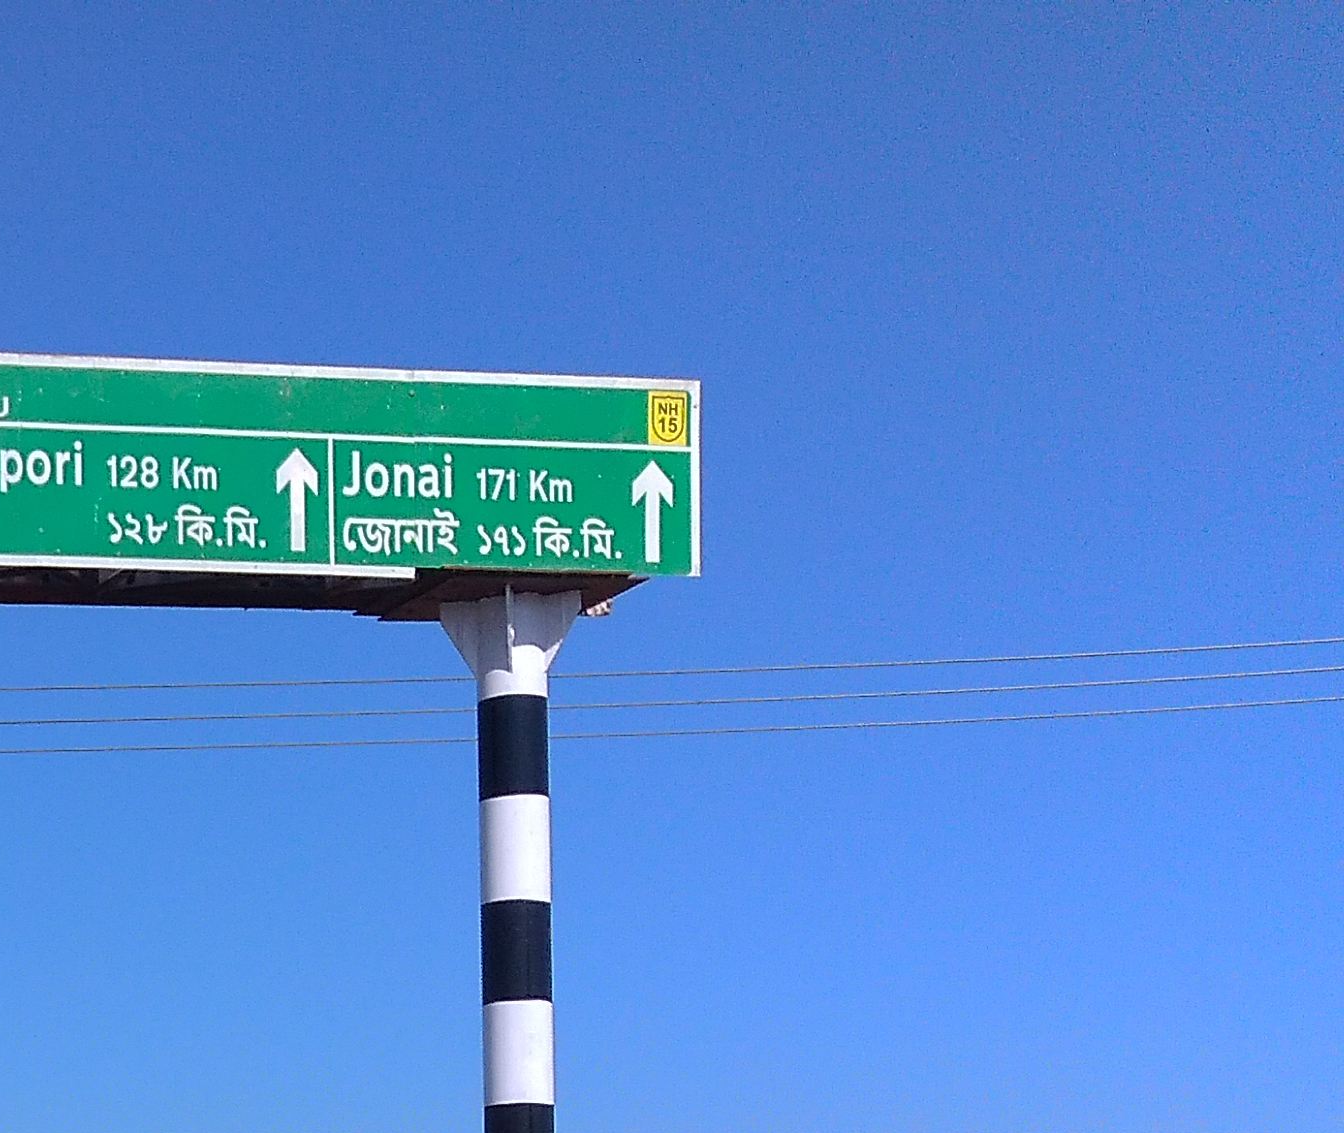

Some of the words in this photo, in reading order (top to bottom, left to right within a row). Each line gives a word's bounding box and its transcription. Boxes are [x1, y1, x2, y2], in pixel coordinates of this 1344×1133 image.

[659, 404, 677, 415] NH
[659, 418, 677, 433] 15
[108, 456, 158, 488] 128
[173, 458, 217, 490] Km
[343, 451, 451, 497] Jonai
[477, 469, 515, 500] 171
[530, 470, 572, 502] Km
[109, 513, 167, 544] ১২৮
[175, 505, 266, 547] কি.মি.
[343, 508, 459, 555] জোনাই
[478, 525, 525, 555] ১৭১
[533, 517, 621, 559] কি.মি.
